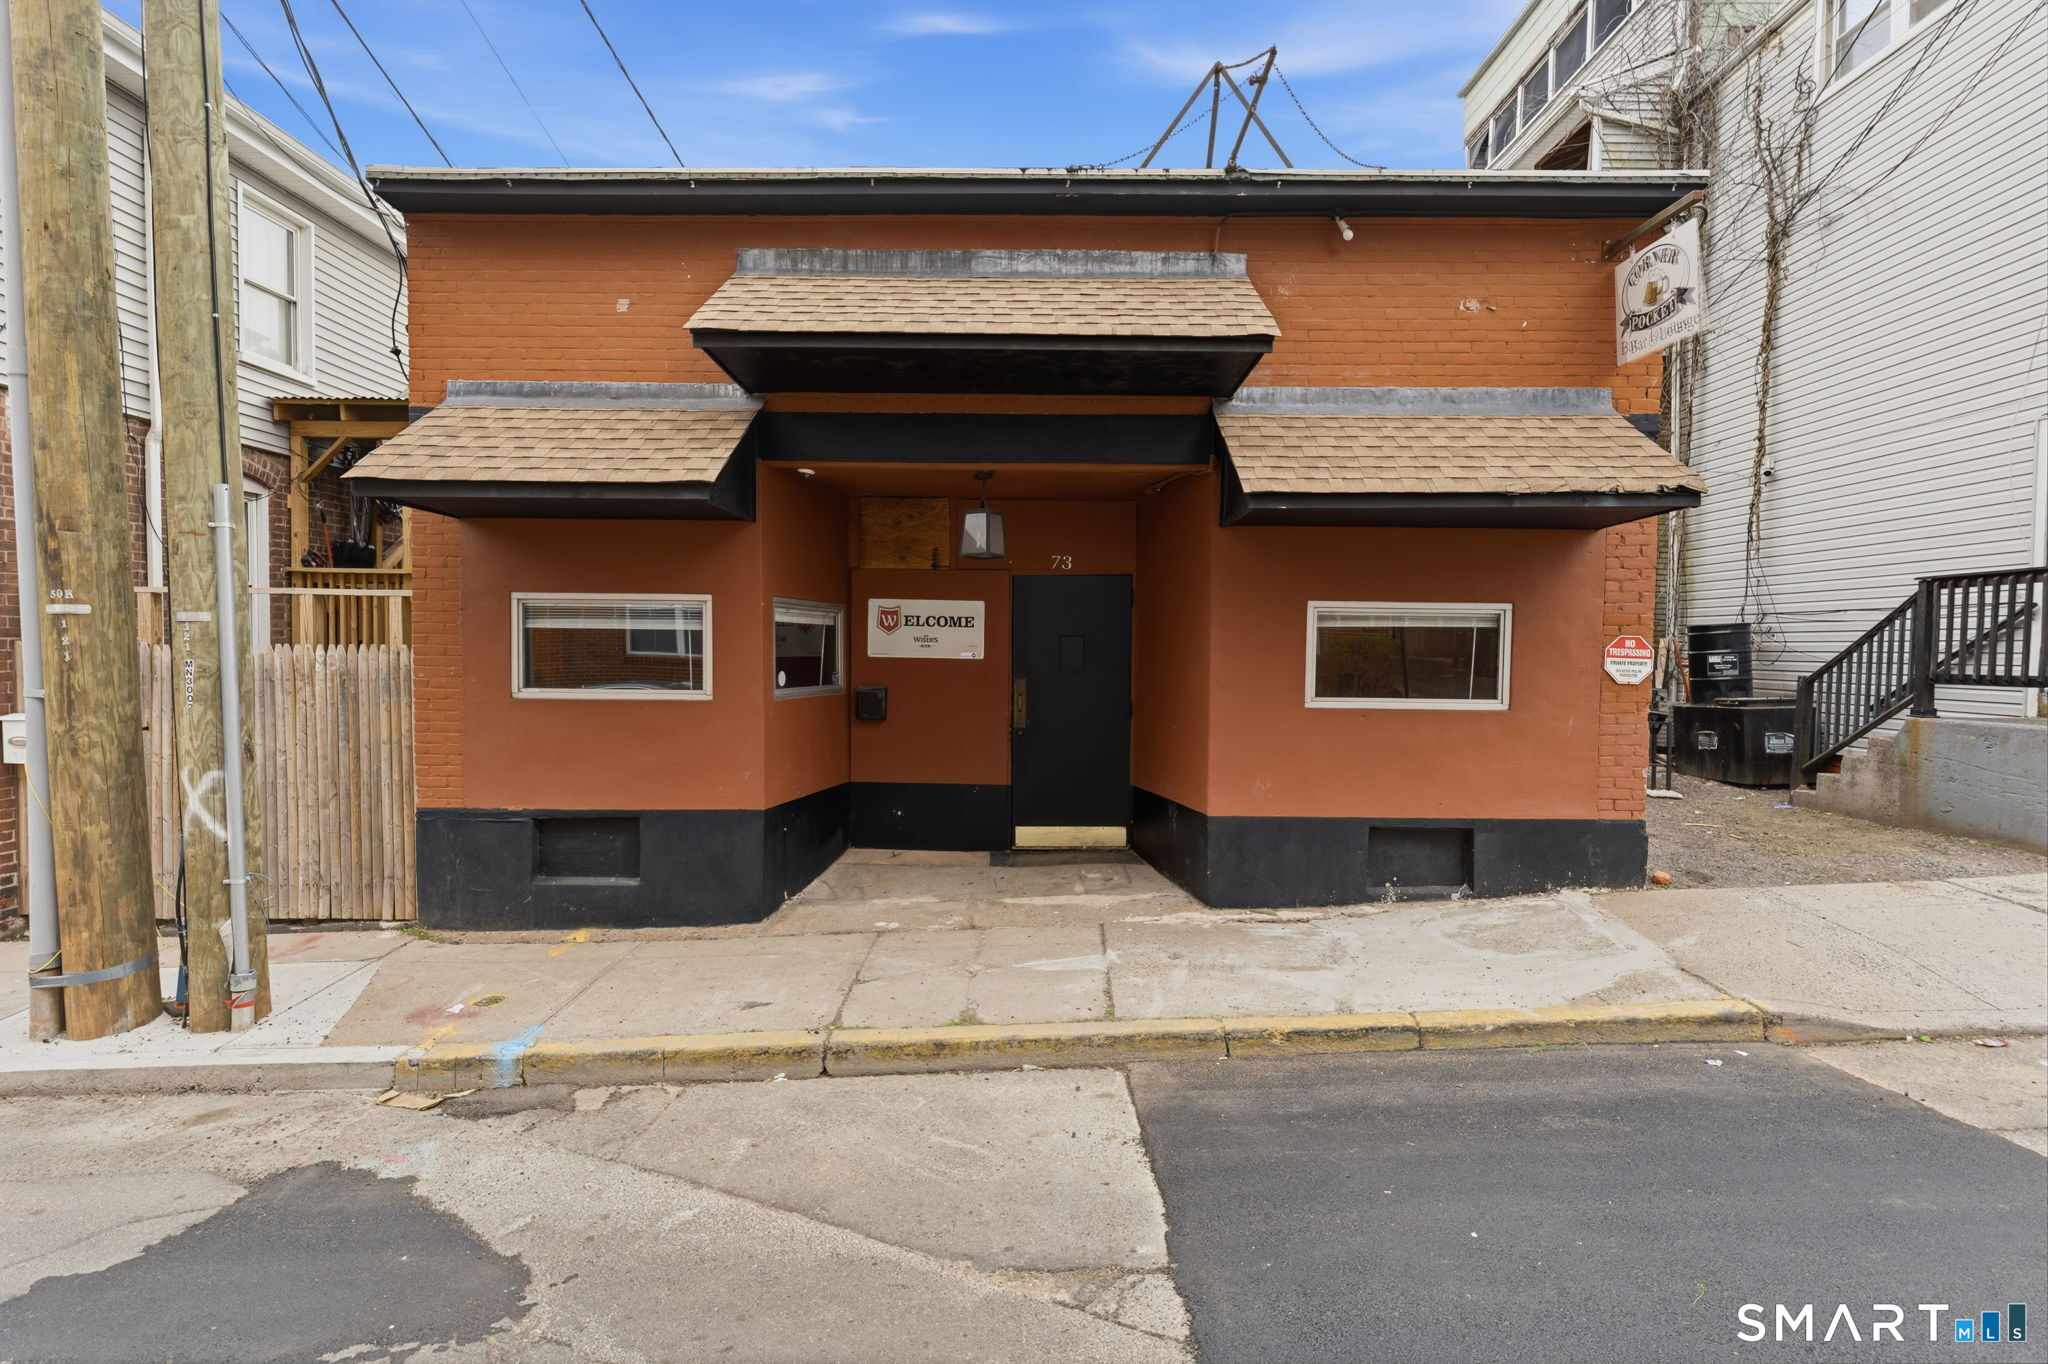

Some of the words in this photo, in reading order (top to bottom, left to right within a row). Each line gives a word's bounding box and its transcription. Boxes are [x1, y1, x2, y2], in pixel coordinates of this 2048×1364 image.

[1628, 248, 1680, 287] CORNER
[1631, 299, 1675, 331] POCKET
[1051, 555, 1072, 570] 73
[881, 613, 975, 628] WELCOME
[1625, 639, 1636, 648] NO
[1609, 647, 1651, 657] TRESPASSING
